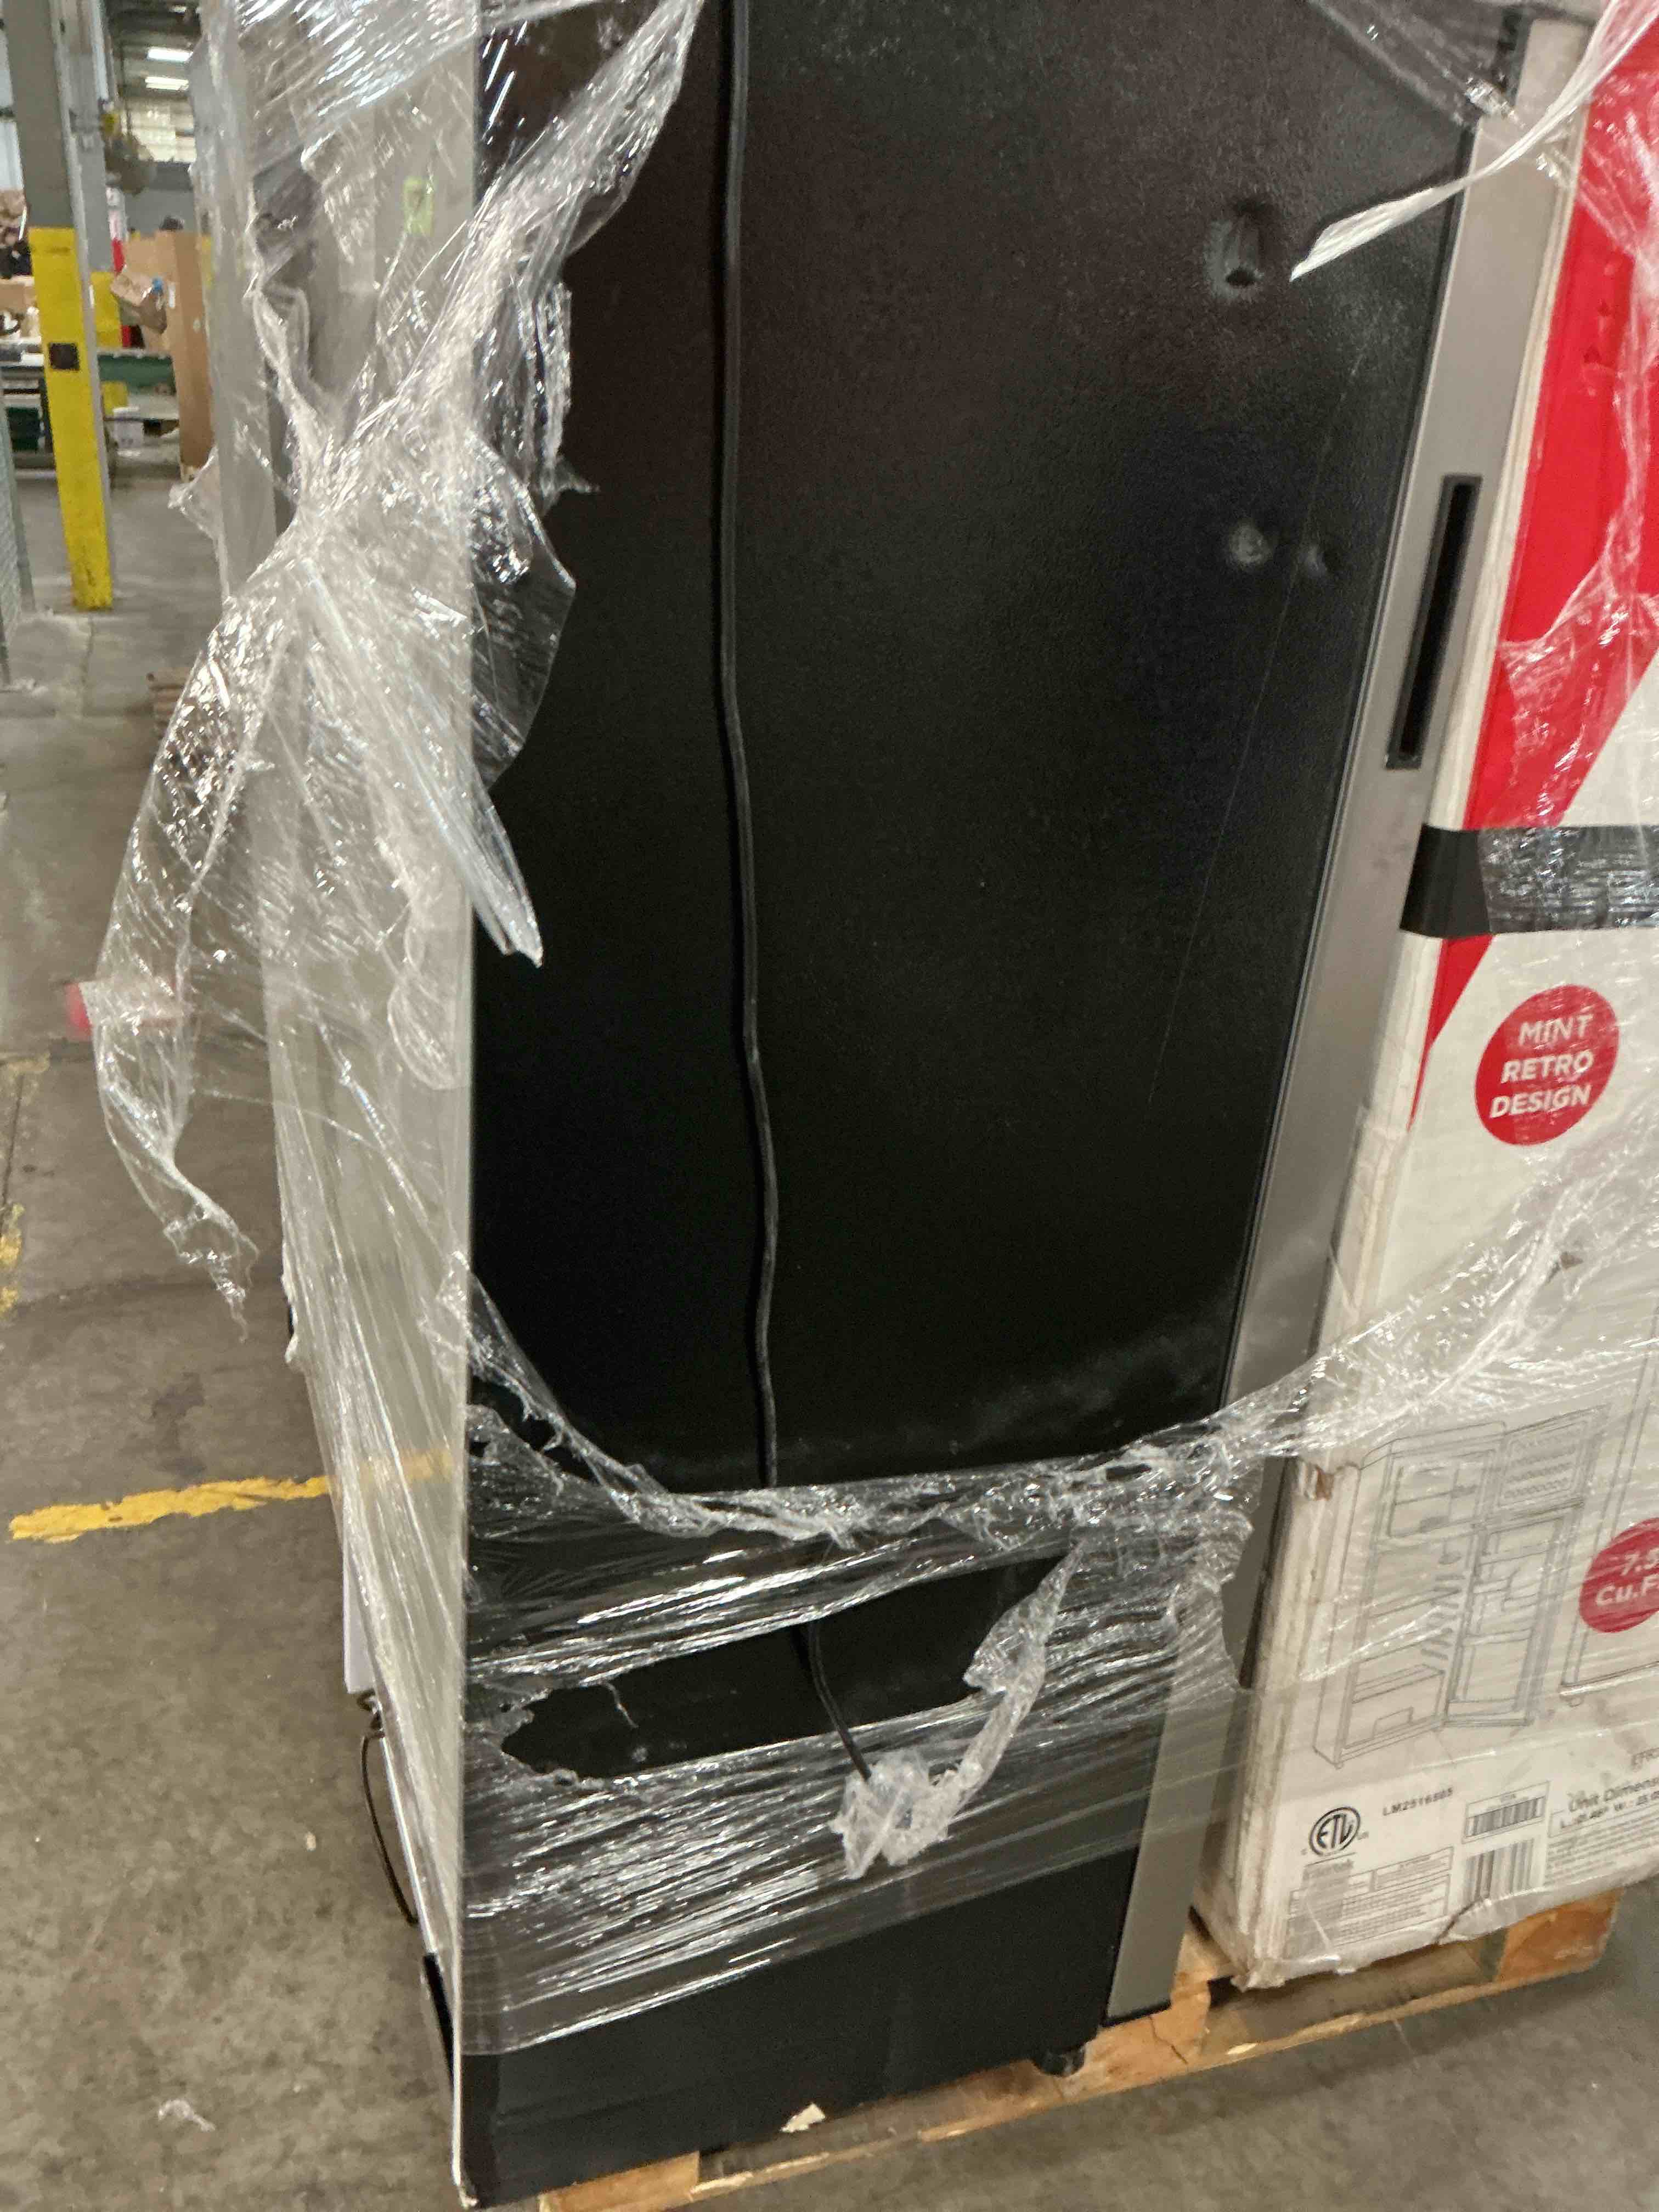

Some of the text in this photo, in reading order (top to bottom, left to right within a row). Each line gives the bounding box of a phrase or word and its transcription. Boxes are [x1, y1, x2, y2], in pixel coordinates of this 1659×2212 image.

[1519, 1014, 1594, 1046] MINT
[1500, 1049, 1594, 1084] RETRO
[1489, 1084, 1592, 1119] DESIGN
[1316, 1812, 1354, 1849] ETL
